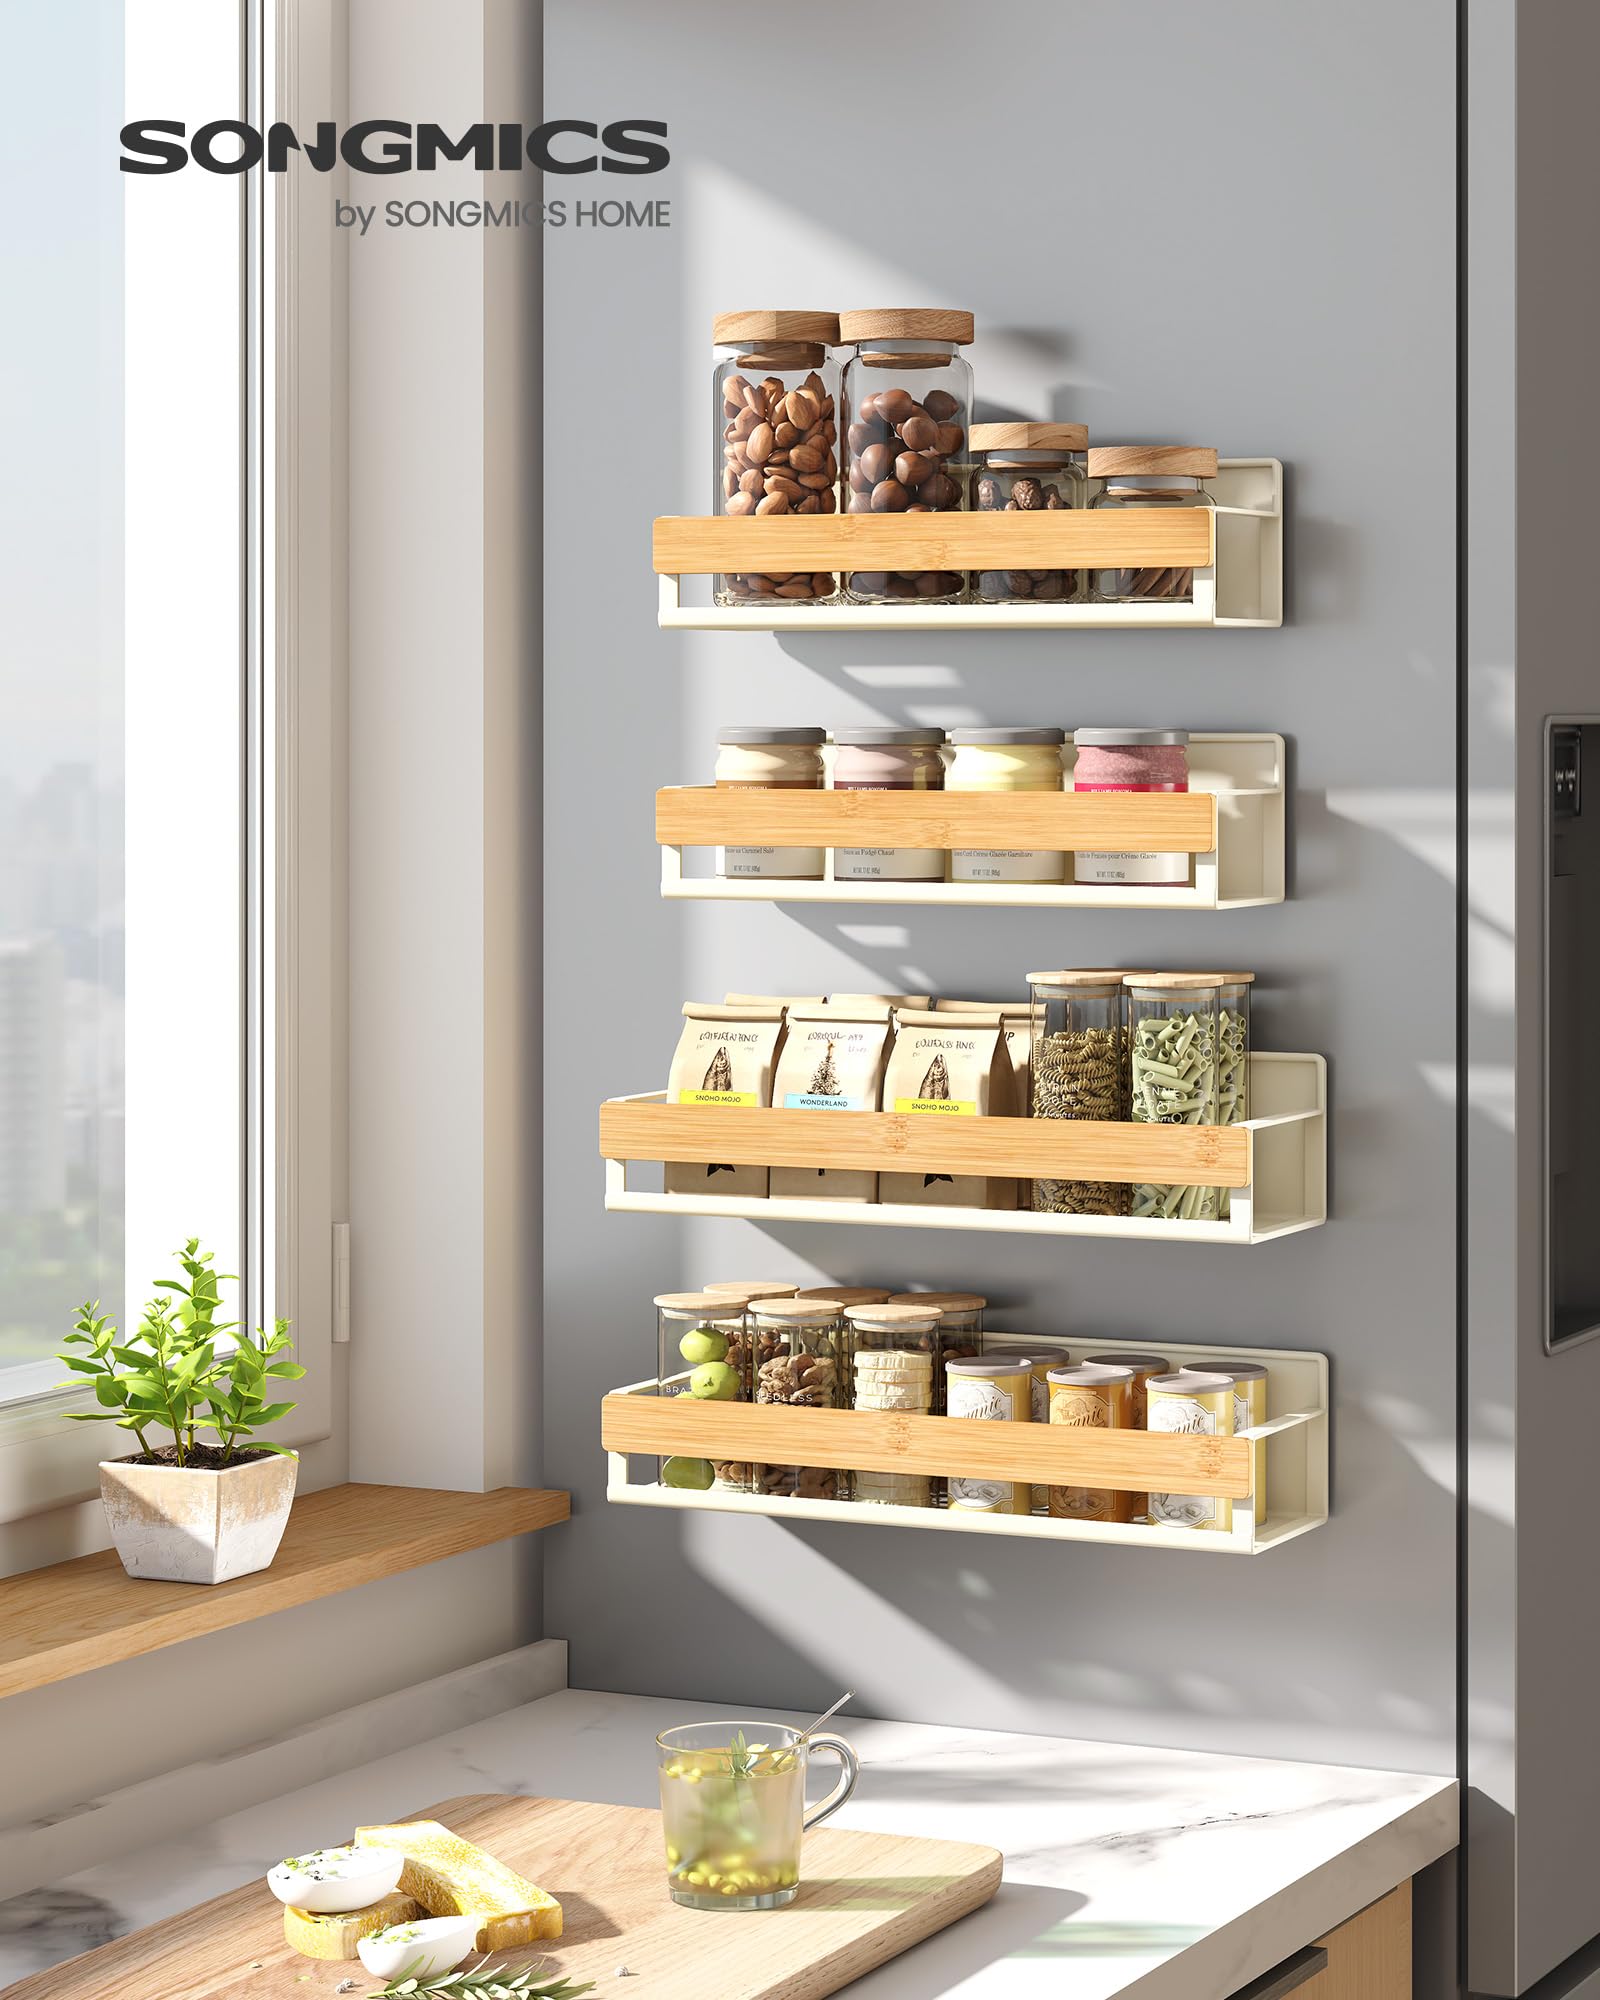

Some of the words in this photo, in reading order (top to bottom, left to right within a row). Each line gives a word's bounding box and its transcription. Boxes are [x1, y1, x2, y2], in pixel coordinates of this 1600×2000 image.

[695, 1094, 720, 1102] SNOHO
[799, 1098, 848, 1108] WONDERLAND
[911, 1103, 937, 1111] SNOHO
